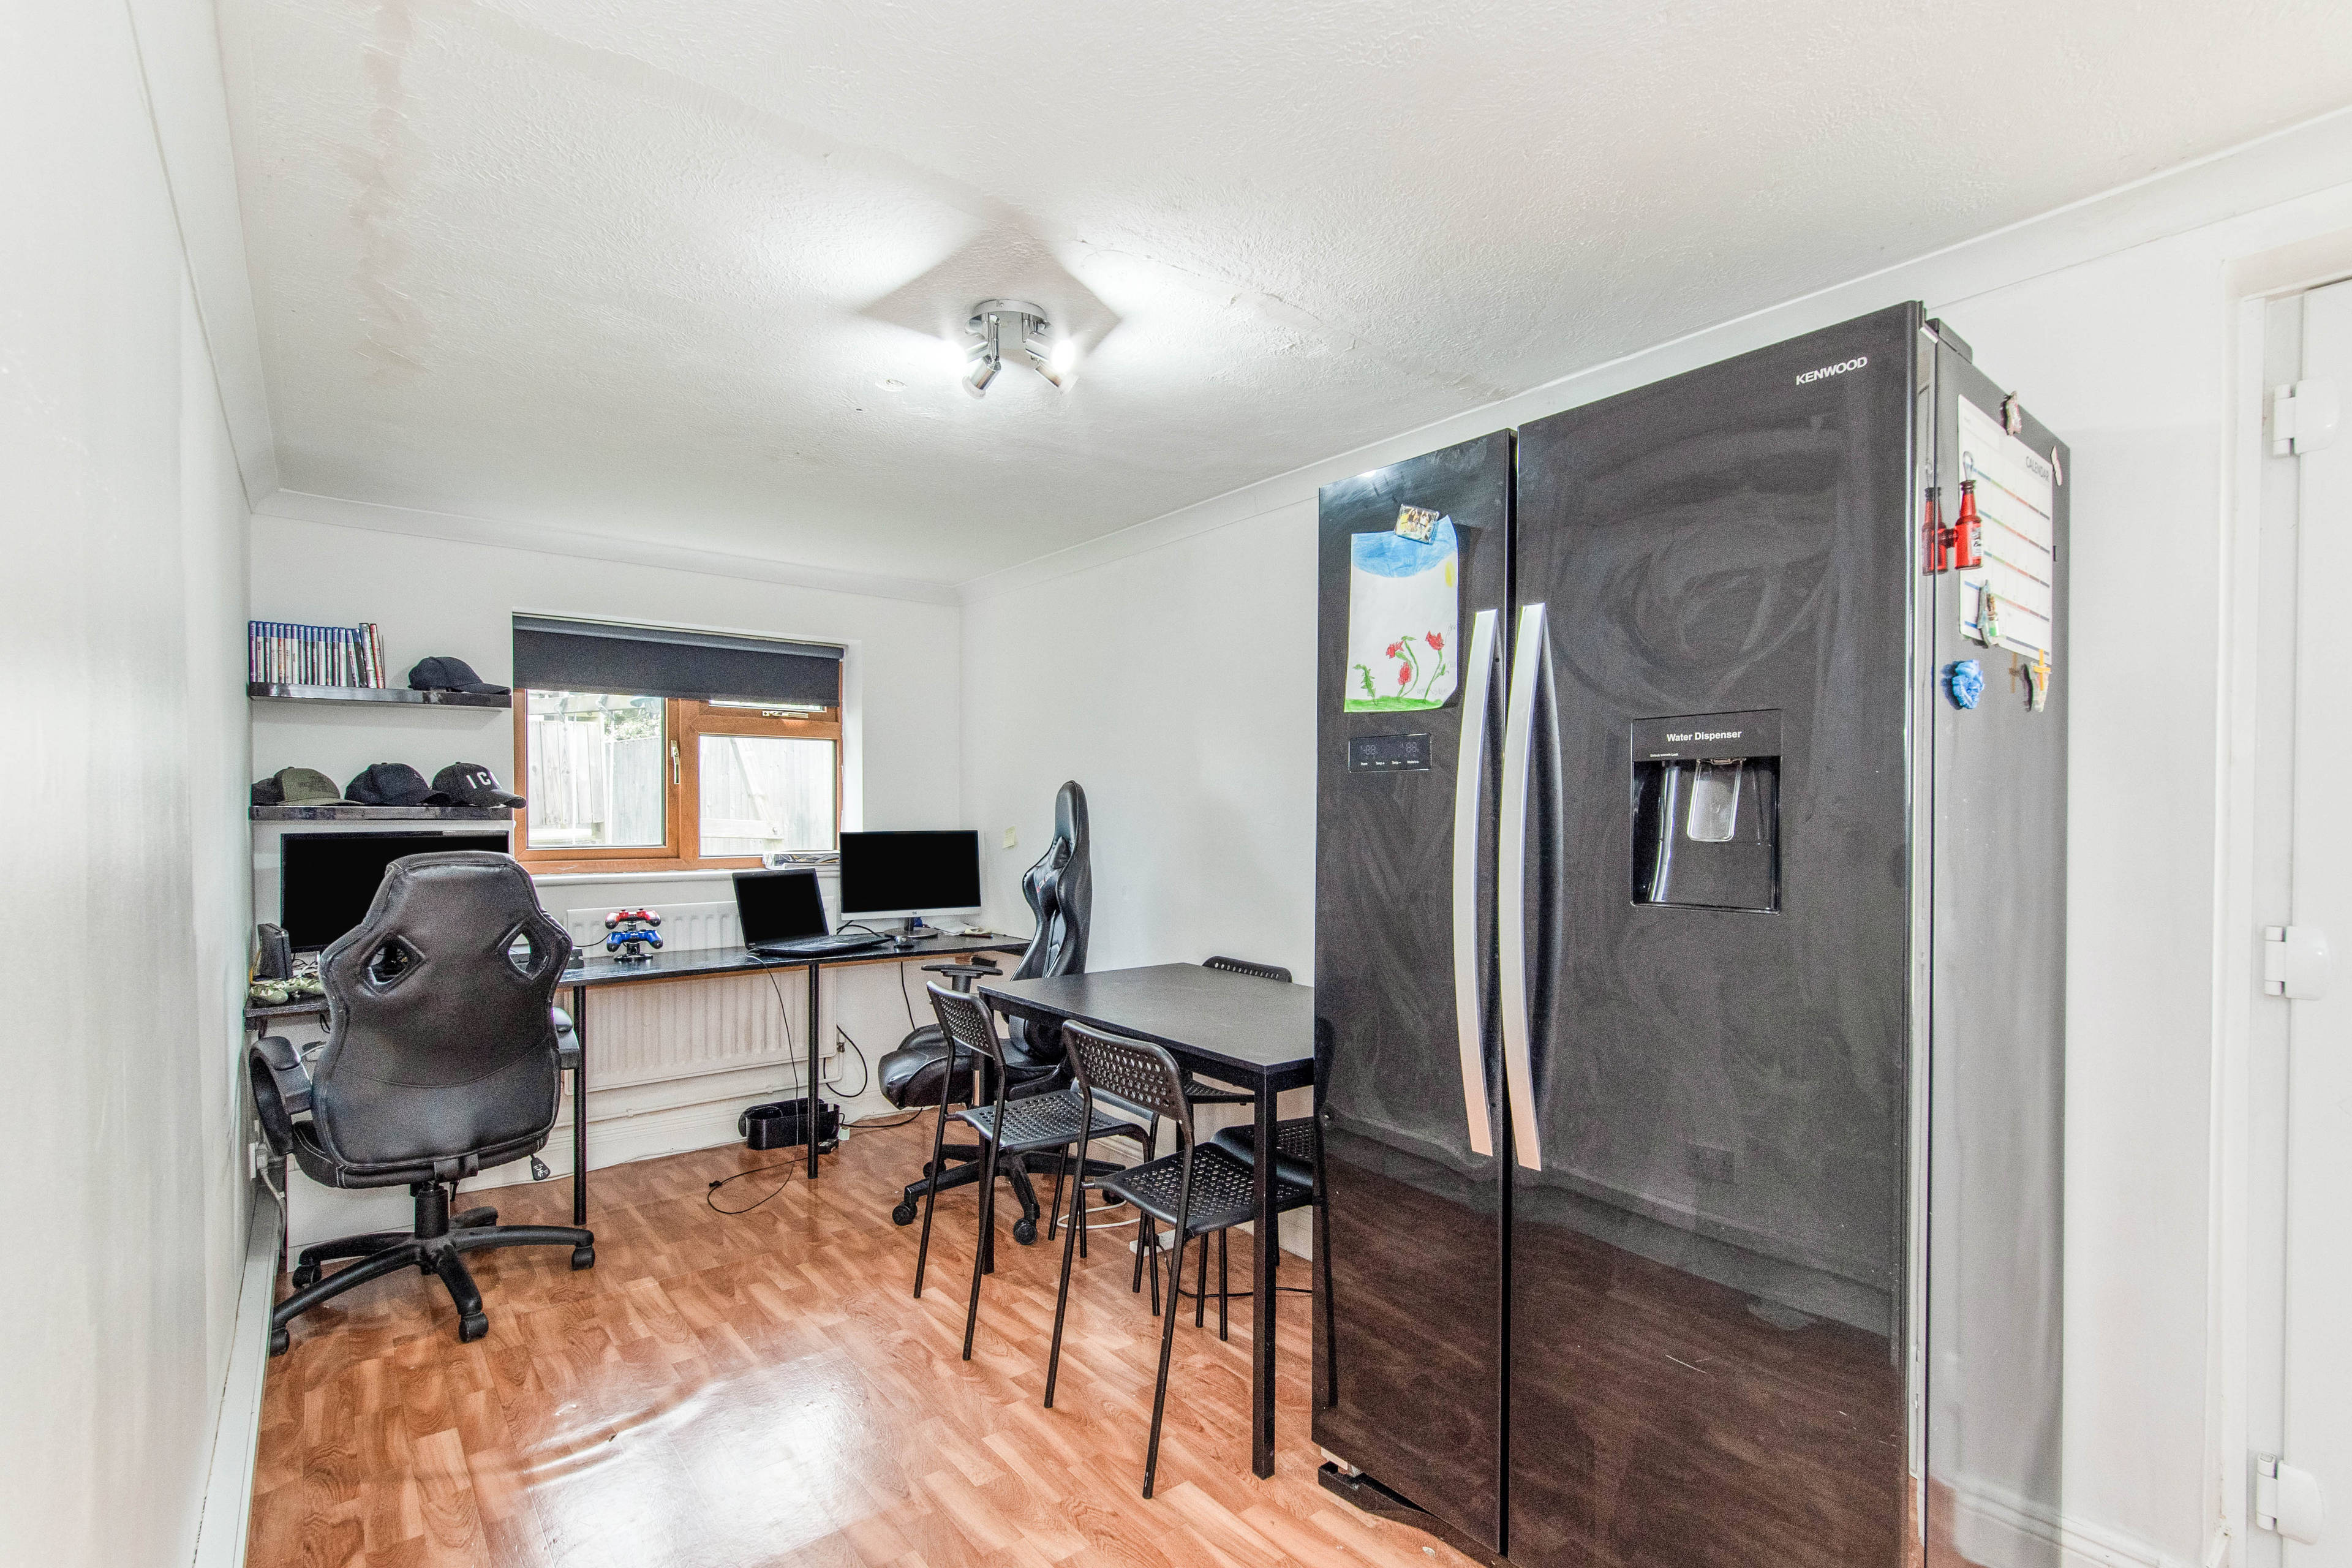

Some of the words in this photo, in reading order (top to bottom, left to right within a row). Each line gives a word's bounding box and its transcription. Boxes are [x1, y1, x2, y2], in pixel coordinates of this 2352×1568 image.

[1795, 356, 1868, 385] KENWOOD
[1666, 733, 1693, 742] Water
[1694, 731, 1743, 742] Dispenser
